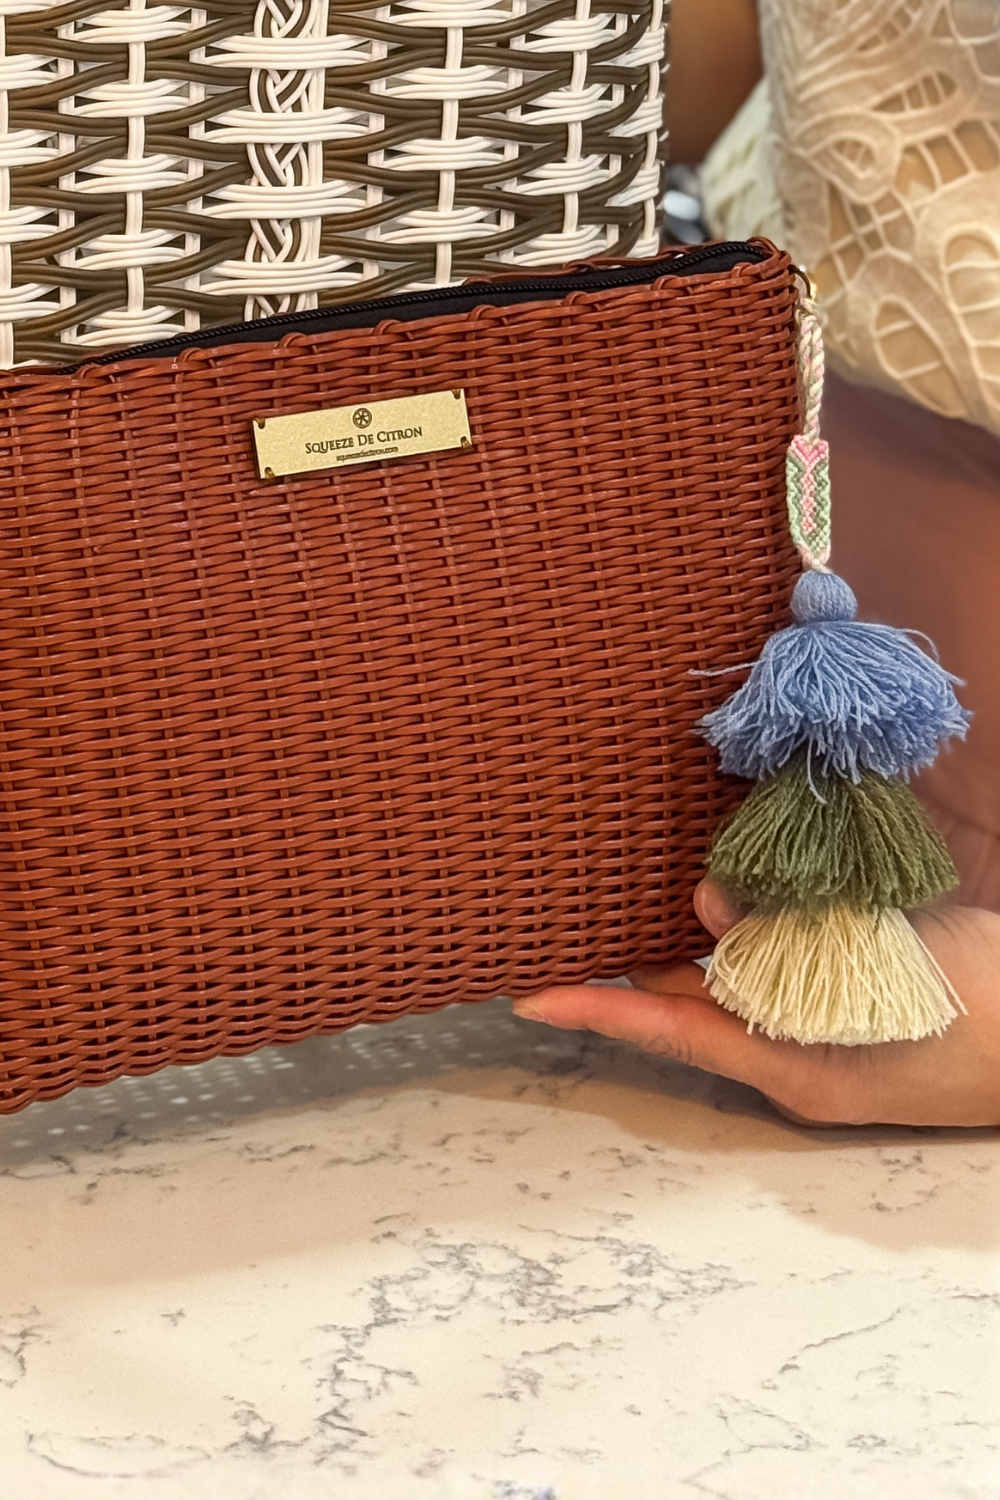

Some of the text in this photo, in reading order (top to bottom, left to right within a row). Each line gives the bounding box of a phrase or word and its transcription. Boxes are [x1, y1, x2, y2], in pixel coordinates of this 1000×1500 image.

[305, 426, 423, 454] SQUEEZE DE CITRON
